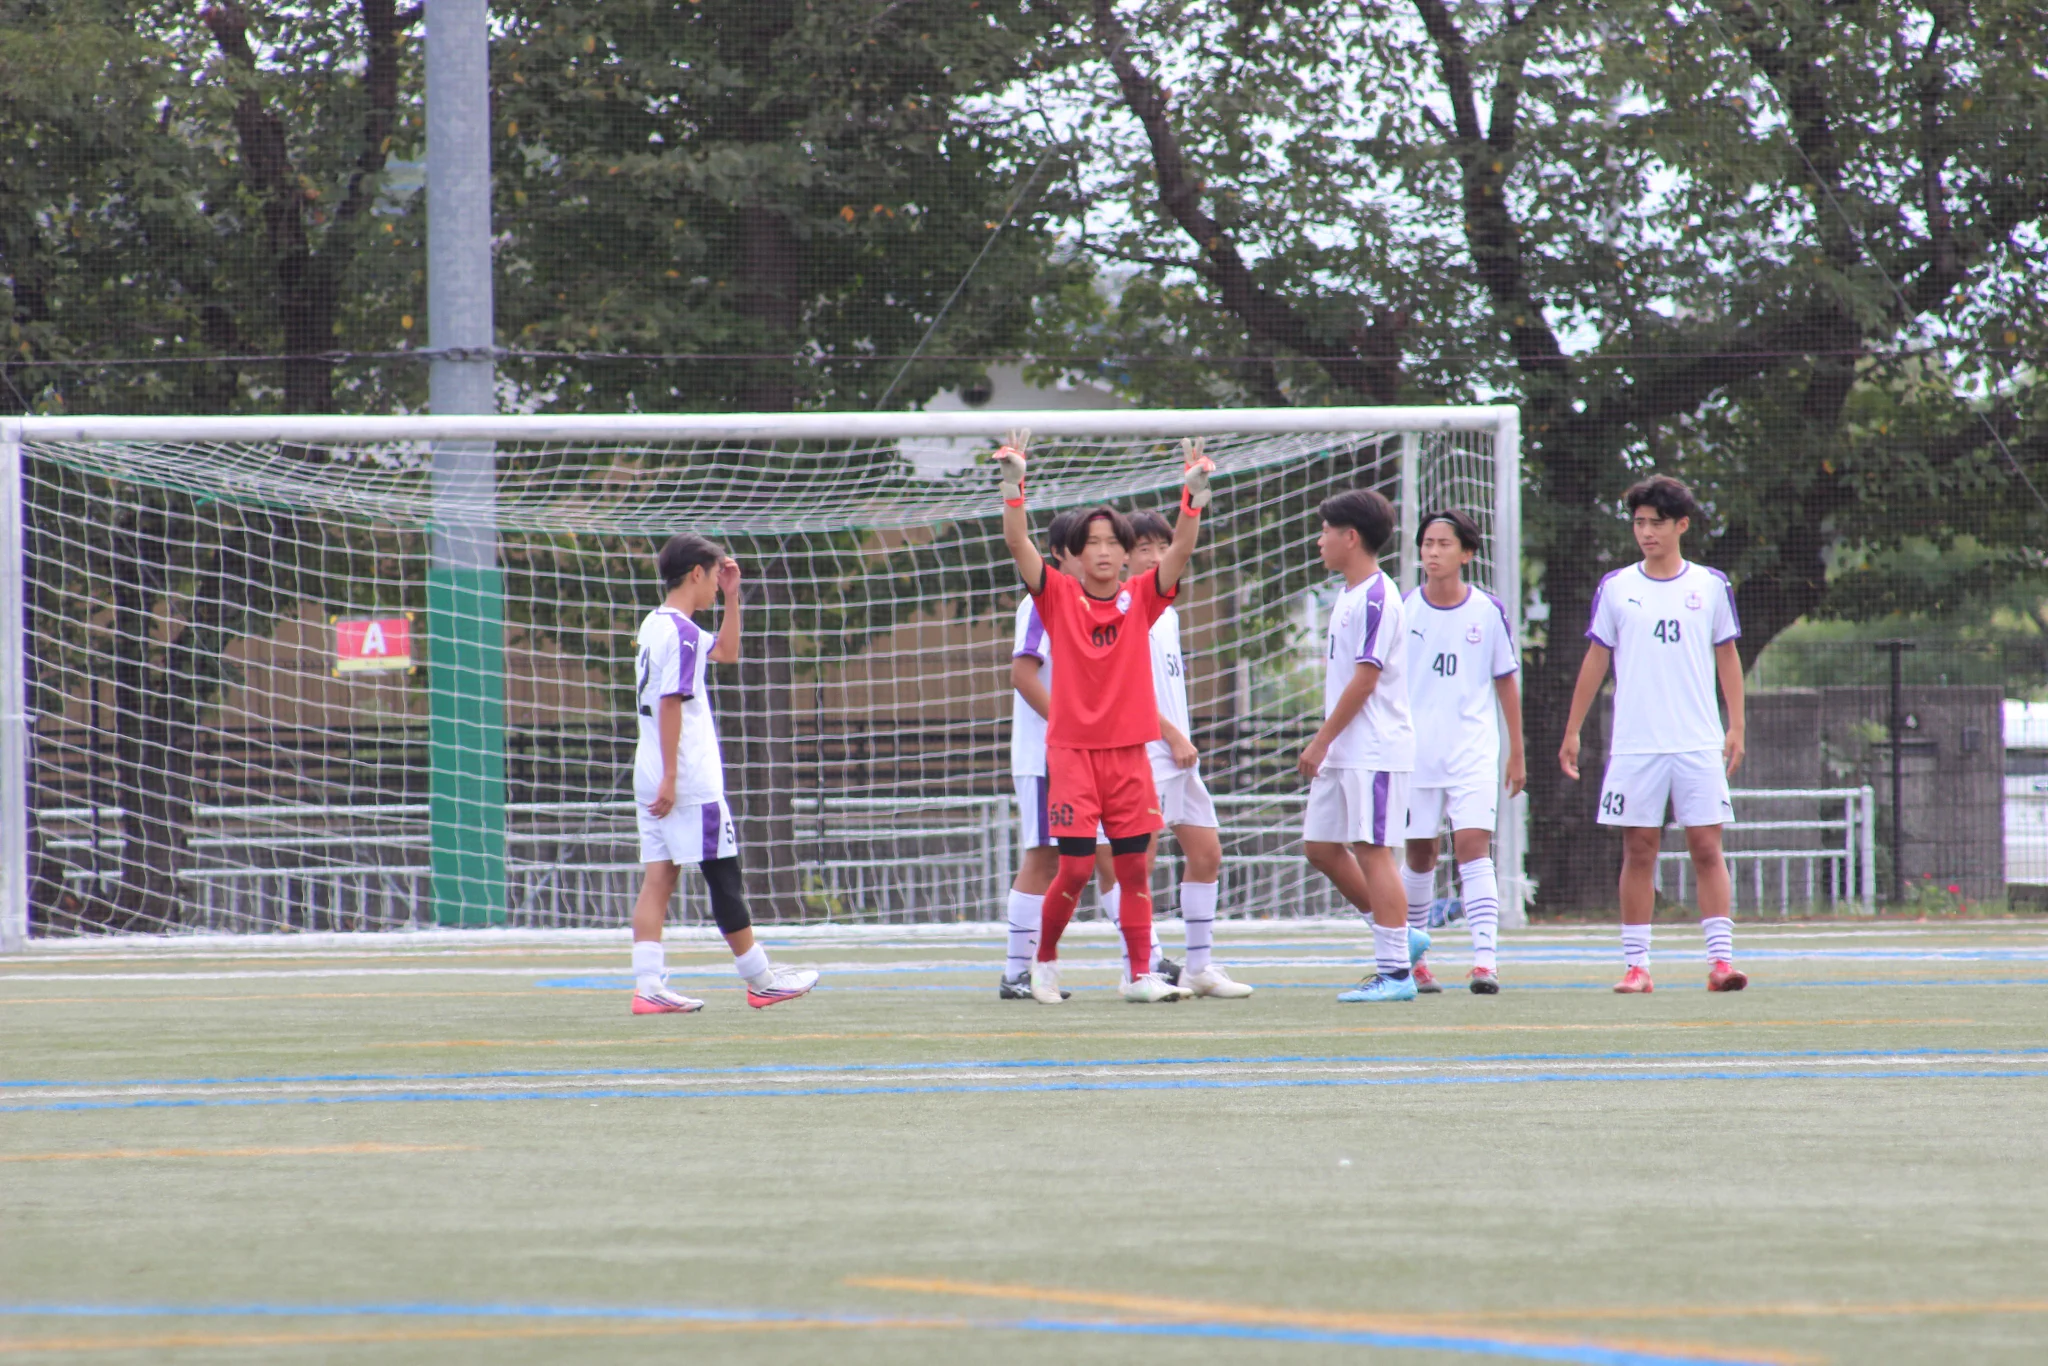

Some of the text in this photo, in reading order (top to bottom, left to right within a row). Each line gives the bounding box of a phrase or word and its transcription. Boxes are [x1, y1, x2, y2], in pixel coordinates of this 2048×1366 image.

[361, 622, 387, 655] A
[1092, 625, 1117, 647] 60
[1654, 619, 1681, 643] 43
[1432, 653, 1457, 677] 40
[1049, 803, 1074, 826] 60
[1602, 791, 1625, 816] 43
